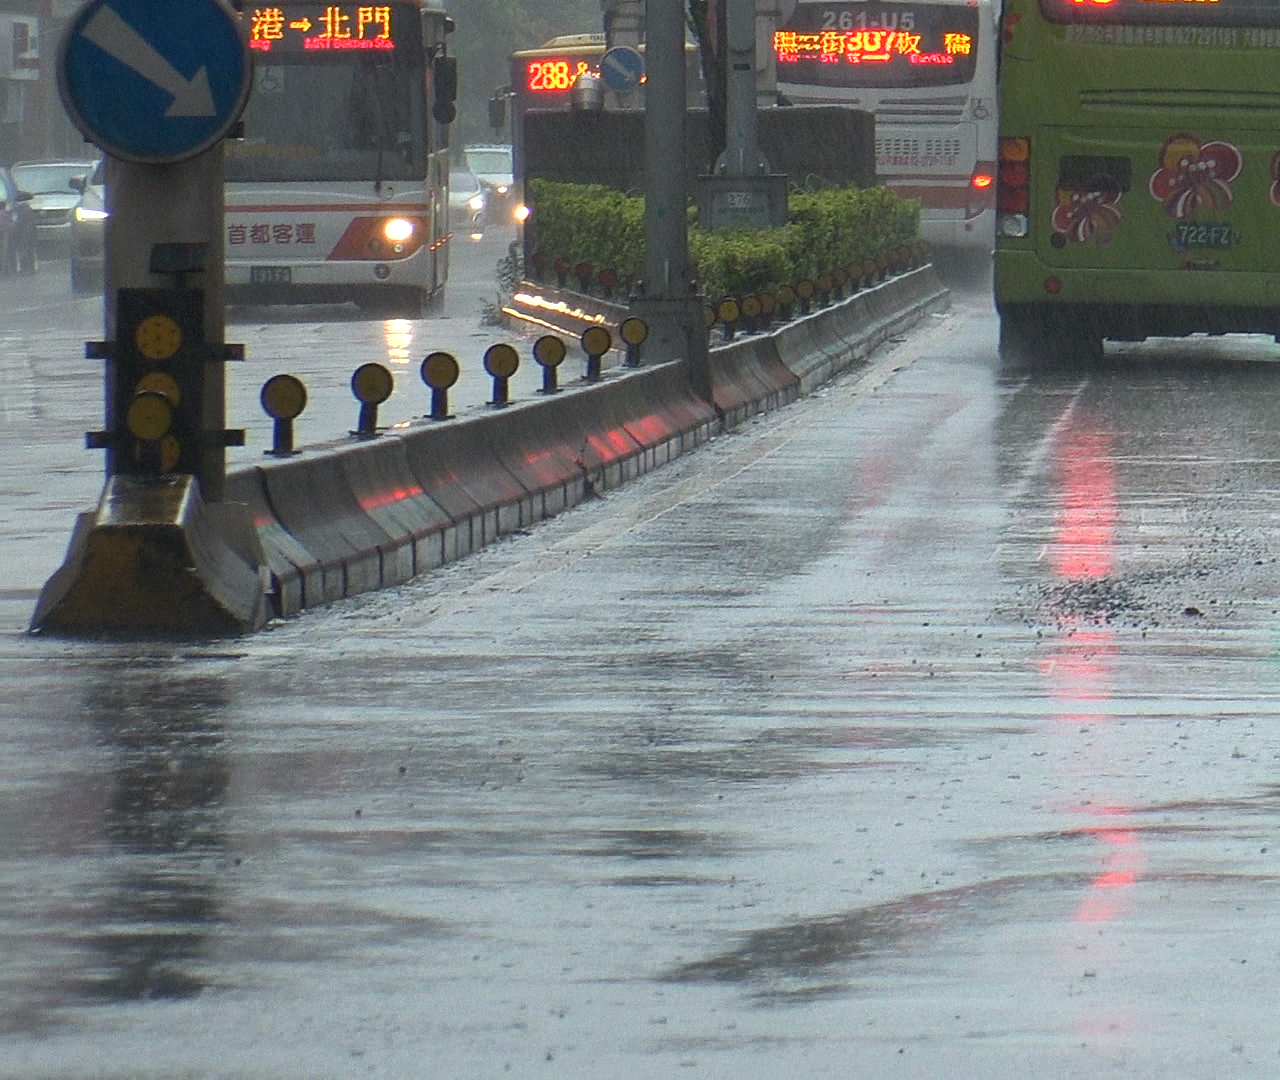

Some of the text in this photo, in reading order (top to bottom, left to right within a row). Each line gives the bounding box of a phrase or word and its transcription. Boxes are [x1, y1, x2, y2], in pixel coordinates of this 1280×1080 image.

[317, 6, 390, 39] 北門
[821, 11, 915, 30] 261-U5
[528, 60, 570, 90] 288
[228, 223, 316, 245] 首都客運
